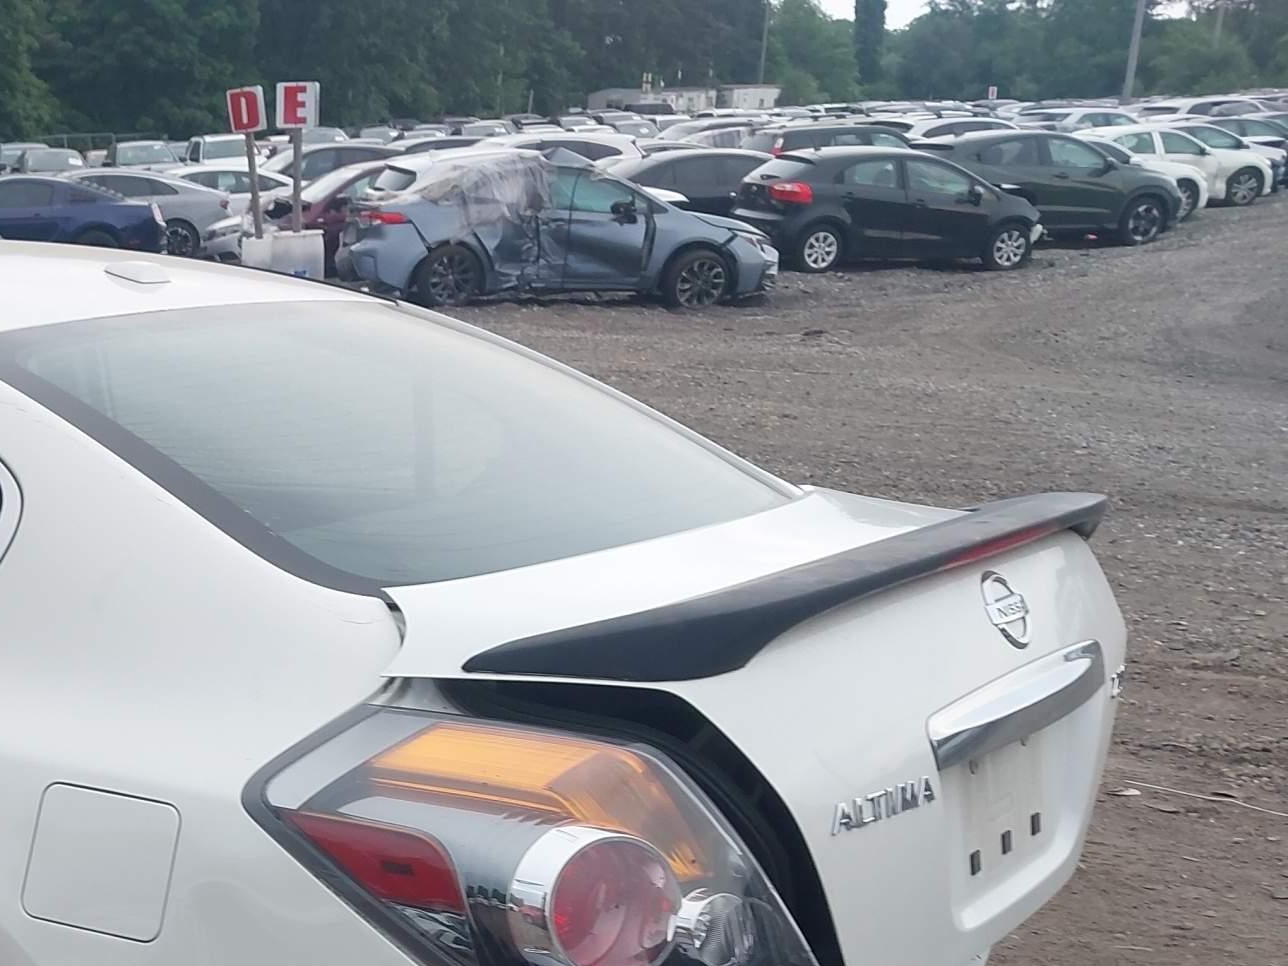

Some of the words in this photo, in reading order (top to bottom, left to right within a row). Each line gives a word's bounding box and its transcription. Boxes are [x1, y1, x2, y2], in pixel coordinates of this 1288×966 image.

[228, 89, 261, 131] D
[283, 85, 307, 125] E
[830, 776, 935, 836] ALTIMA
